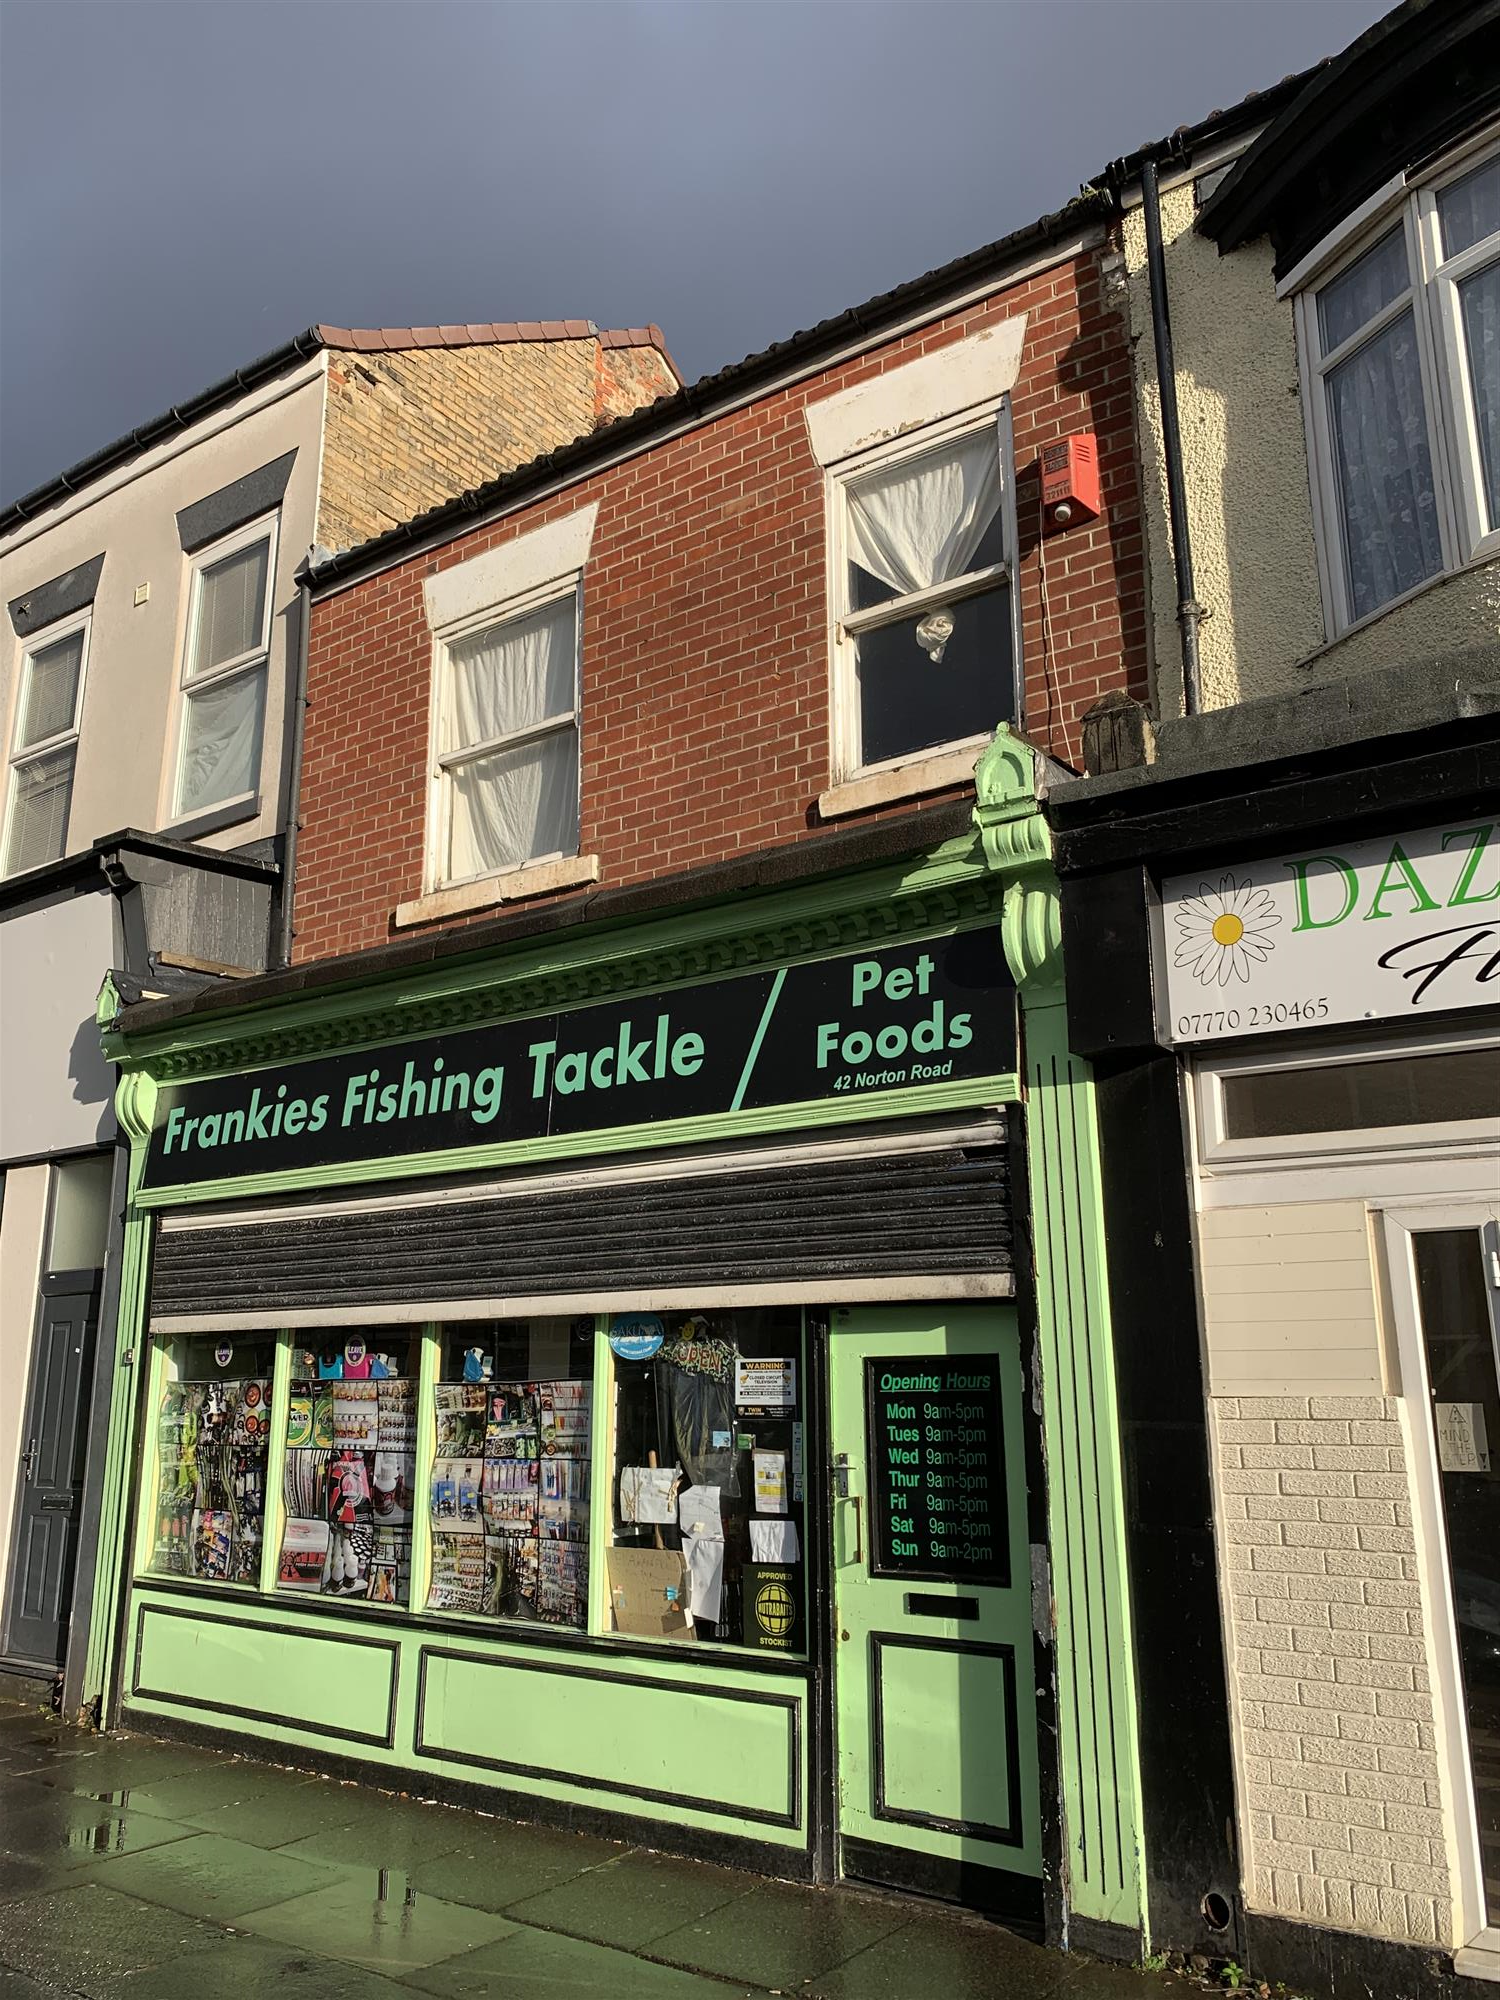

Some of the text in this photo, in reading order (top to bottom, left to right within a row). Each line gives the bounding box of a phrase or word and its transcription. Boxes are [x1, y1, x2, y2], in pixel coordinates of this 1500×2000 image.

[1283, 823, 1500, 932] DAZ
[852, 955, 935, 1007] Pet
[1178, 997, 1329, 1035] 07770 230465
[817, 1000, 973, 1068] Foods
[162, 1085, 329, 1155] Frankies
[342, 1057, 503, 1127] Fishing
[528, 1014, 705, 1098] Tackle
[834, 1061, 953, 1090] 42 Norton Road
[677, 1345, 721, 1373] OPEN
[880, 1373, 991, 1393] Opening Hours
[887, 1403, 984, 1422] Mon 9am-5pm
[887, 1426, 986, 1445] Tues 9am-5pm
[1440, 1430, 1470, 1442] MIND
[1447, 1442, 1471, 1453] THE
[888, 1448, 987, 1468] Wed 9am-5pm
[889, 1471, 988, 1491] Thur 9am-5pm
[890, 1494, 988, 1514] Fri 9am-5pm
[891, 1516, 991, 1538] Sat 9am-5pm
[891, 1539, 992, 1562] Sun 9am-2pm
[757, 1572, 792, 1580] APPROVED
[760, 1637, 792, 1647] STOCKIST
